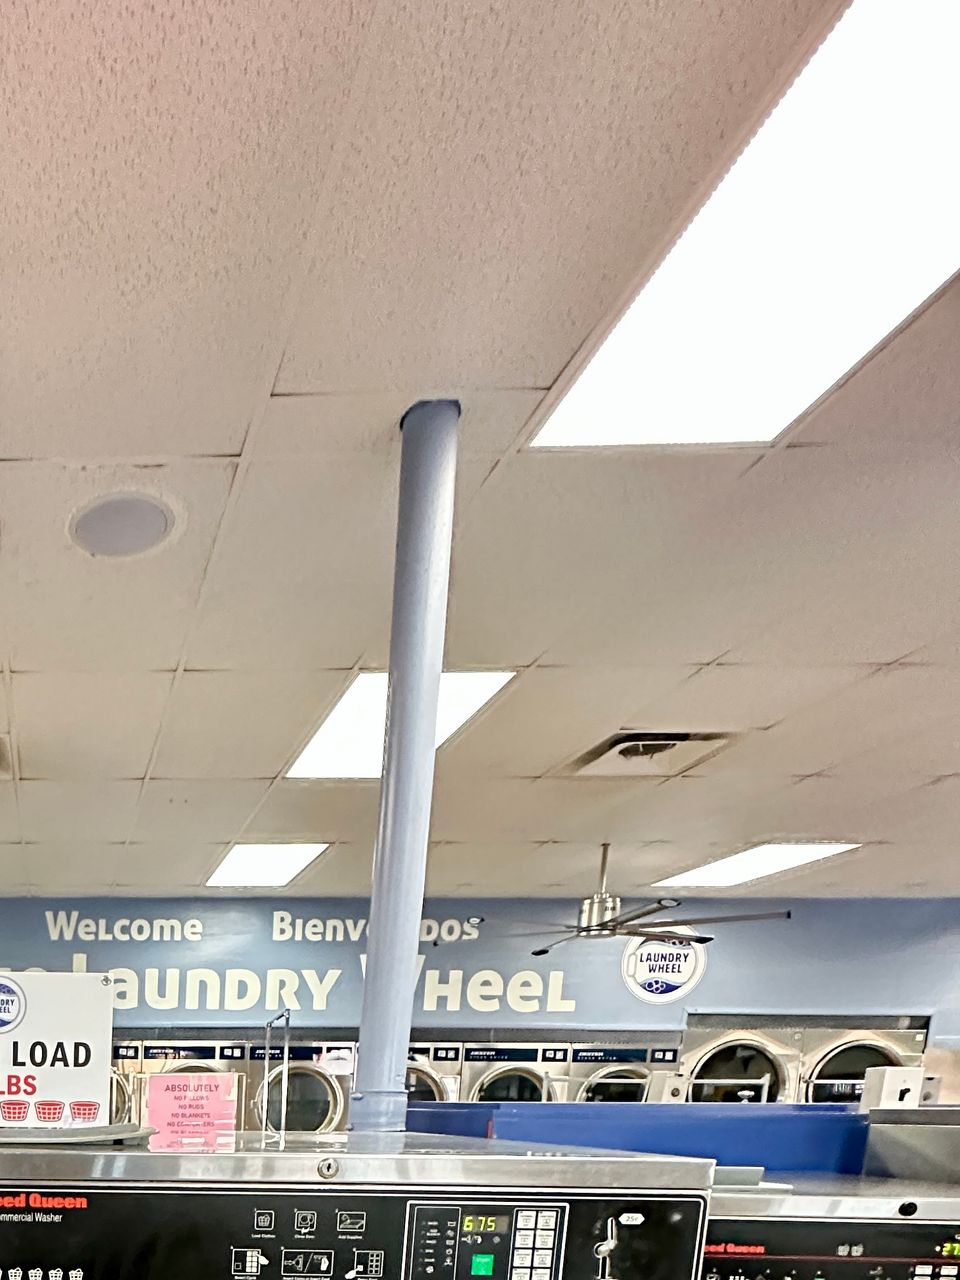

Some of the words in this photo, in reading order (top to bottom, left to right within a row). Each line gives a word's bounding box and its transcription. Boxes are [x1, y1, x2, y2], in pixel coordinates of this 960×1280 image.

[639, 953, 690, 963] LAUNDRY
[648, 963, 682, 973] WHEEL
[12, 1040, 92, 1068] LOAD
[164, 1084, 220, 1092] ABSOLUTELY
[29, 1193, 88, 1209] Queen
[34, 1212, 63, 1222] Washer
